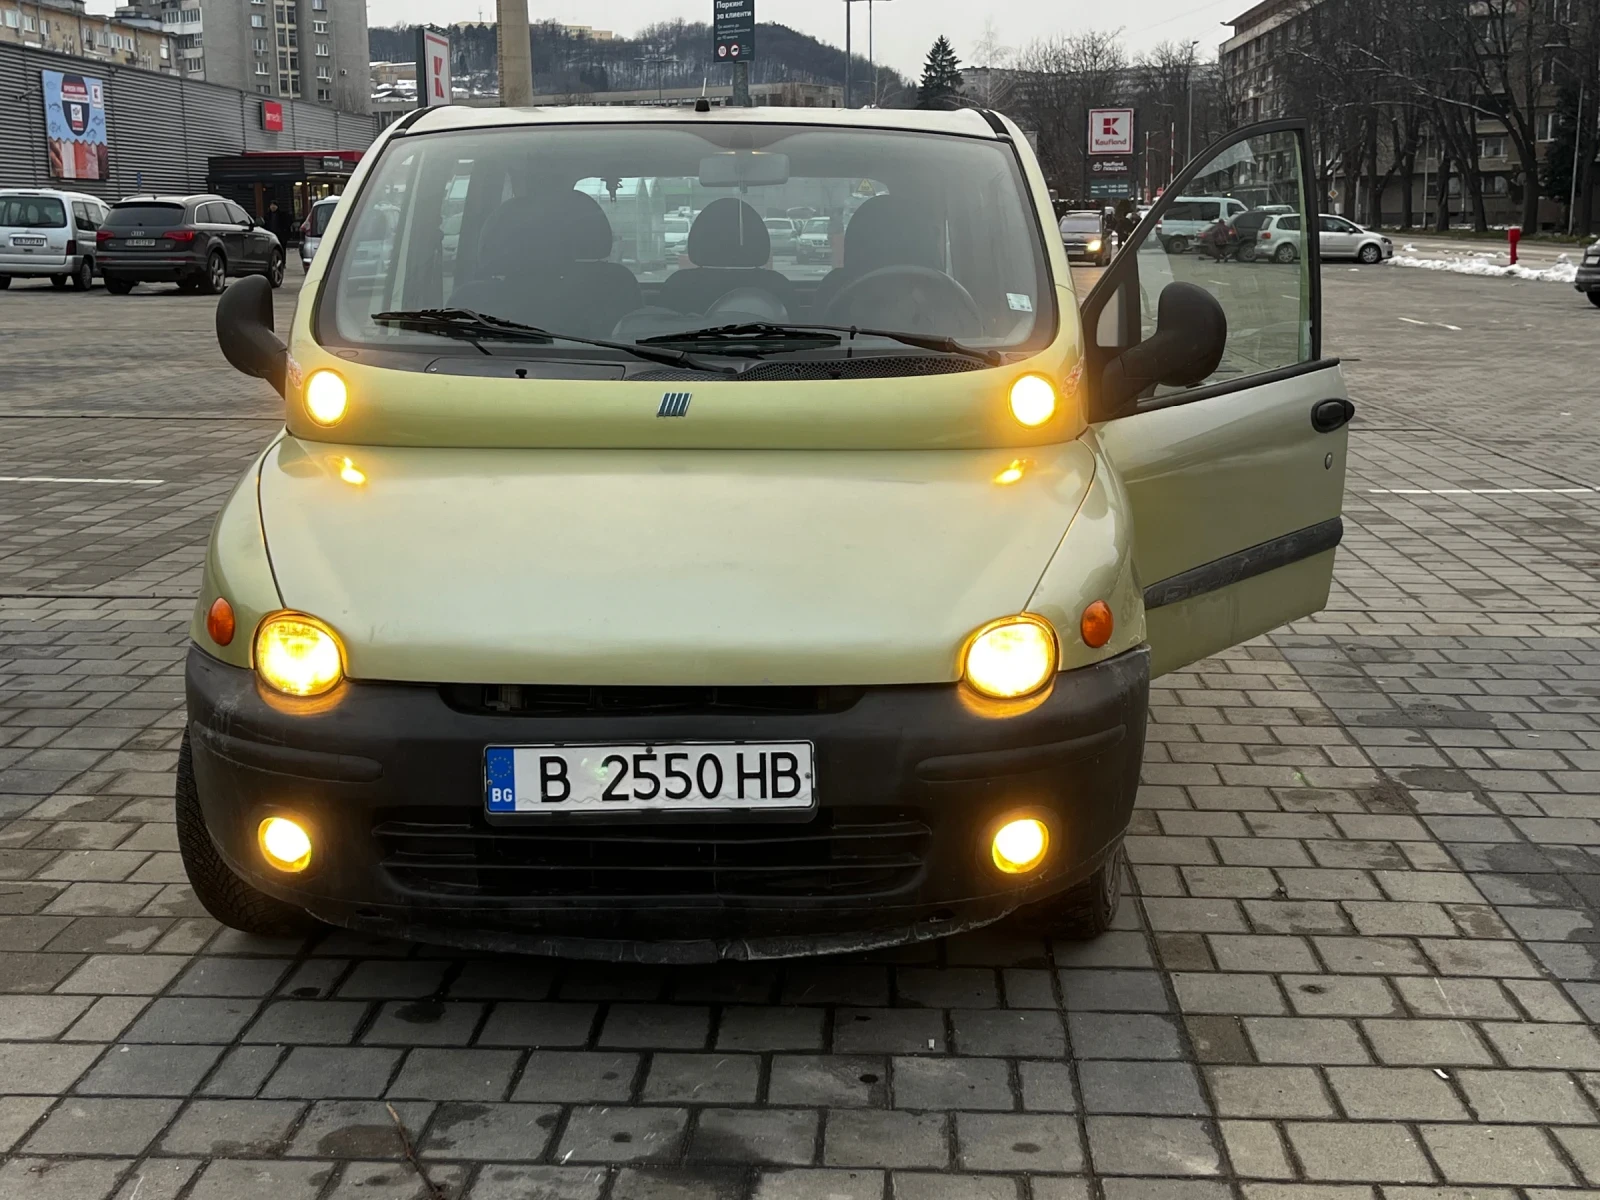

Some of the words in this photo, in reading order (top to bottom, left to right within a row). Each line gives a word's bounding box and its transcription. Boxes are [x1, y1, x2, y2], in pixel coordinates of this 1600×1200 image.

[716, 1, 744, 10] Паркинг
[1103, 118, 1120, 135] K
[1095, 138, 1127, 146] Kaufland
[539, 755, 571, 802] B
[601, 752, 724, 801] 2550
[736, 751, 801, 799] HB
[491, 787, 513, 802] BG
